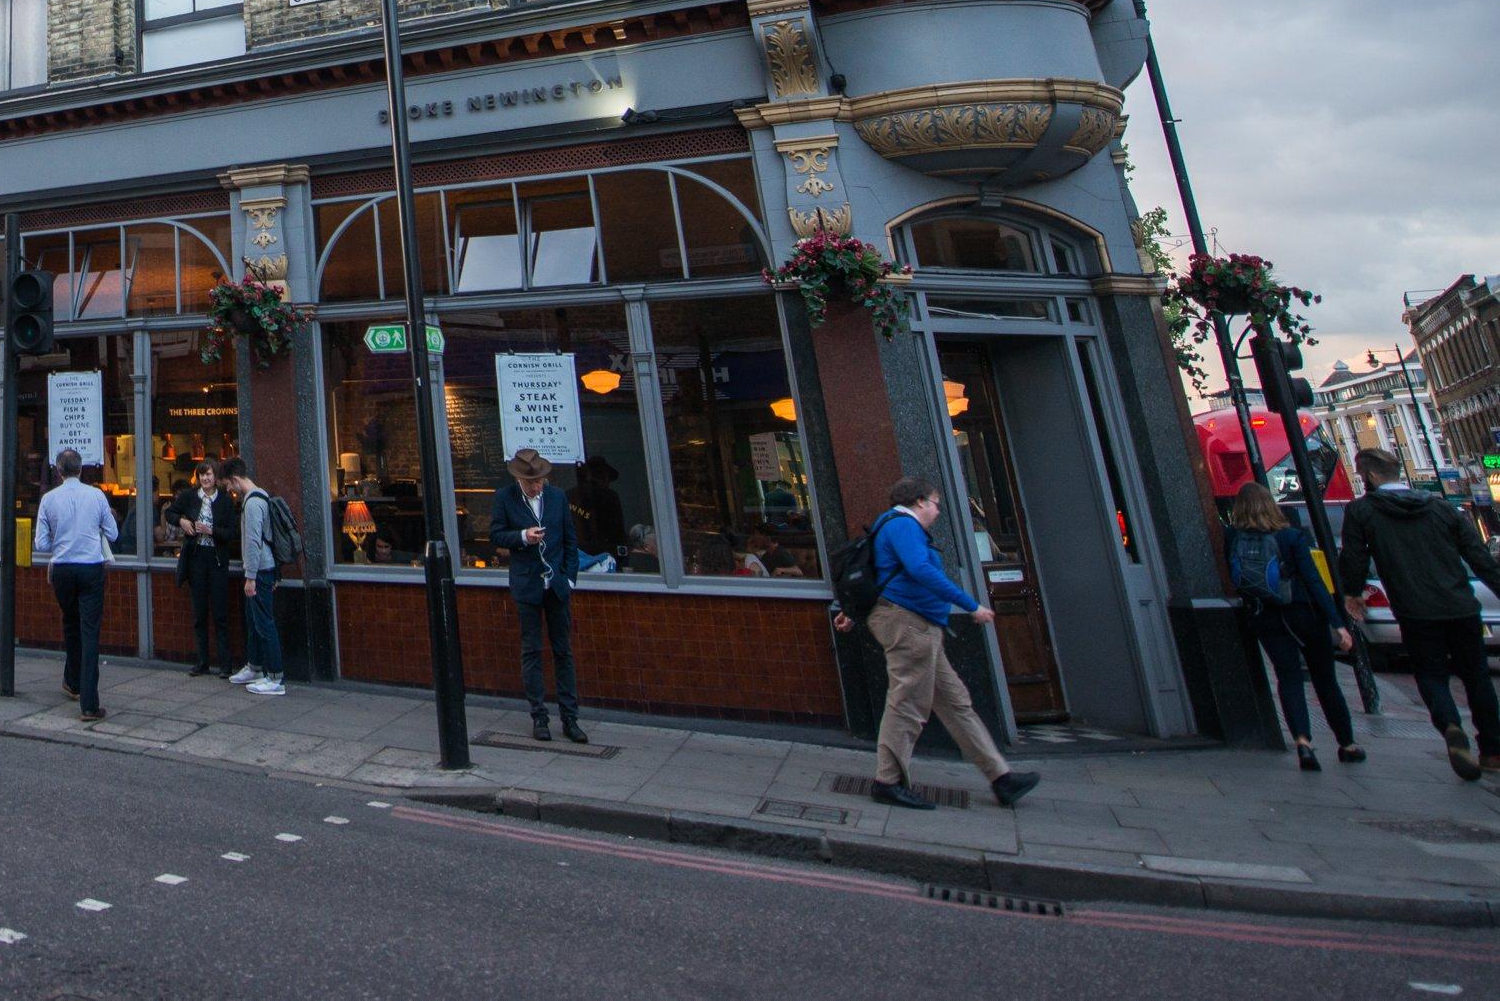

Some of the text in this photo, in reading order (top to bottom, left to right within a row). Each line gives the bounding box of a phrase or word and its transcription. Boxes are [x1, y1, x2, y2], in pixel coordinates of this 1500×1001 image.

[378, 75, 624, 125] SOKE NEWINGTON
[519, 393, 557, 401] STEAK
[169, 407, 238, 416] THE THREE CROWNS
[514, 404, 522, 412] &
[521, 415, 559, 424] NIGHT
[1275, 476, 1300, 491] 73
